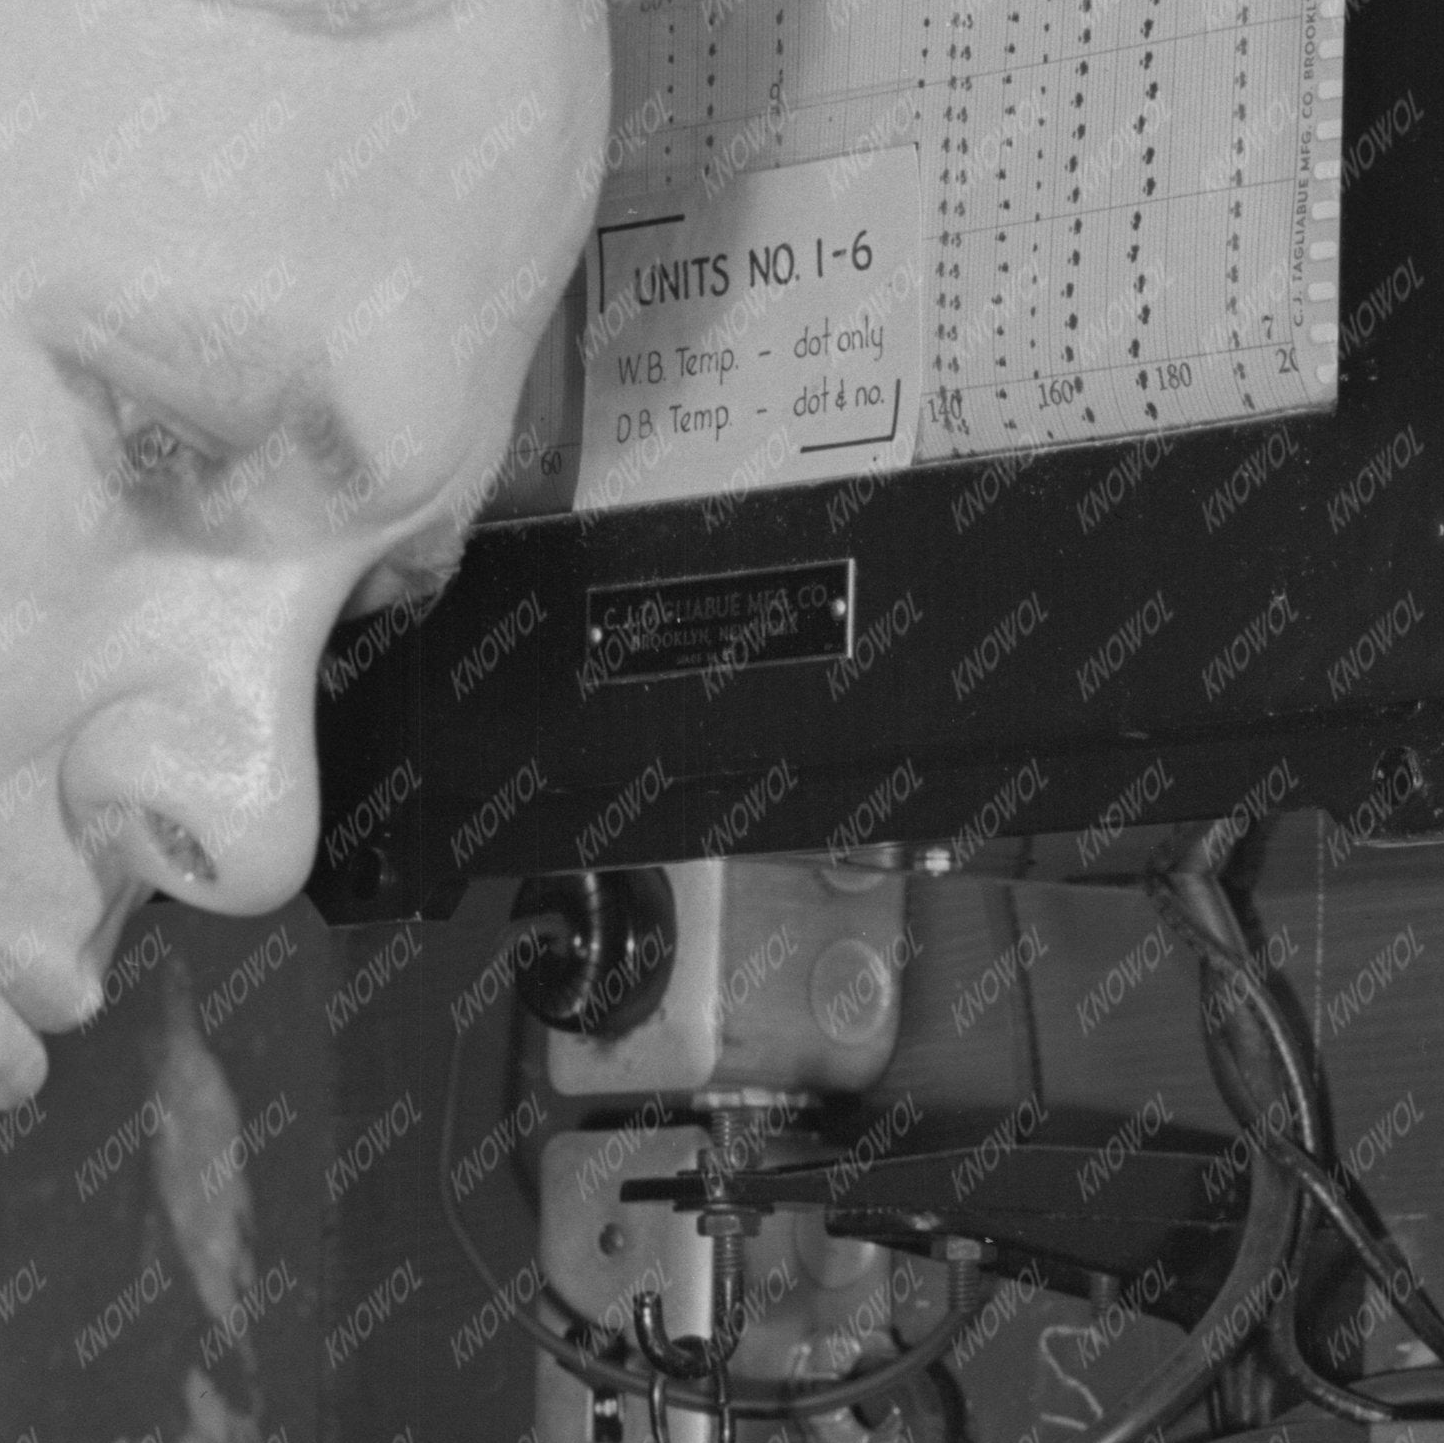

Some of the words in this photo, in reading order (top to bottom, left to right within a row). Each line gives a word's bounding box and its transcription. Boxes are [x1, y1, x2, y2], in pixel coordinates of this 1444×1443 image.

[1302, 86, 1314, 119] CO.
[1300, 125, 1313, 172] MFG.
[1293, 178, 1310, 281] TAGLIABUE
[634, 254, 730, 306] UNITS
[749, 242, 800, 287] NO.
[816, 229, 873, 278] 1-6
[617, 351, 667, 385] W.B.
[677, 347, 739, 386] Temp.
[793, 317, 832, 358] dot
[836, 315, 884, 360] only
[1261, 315, 1274, 341] 7
[1038, 380, 1075, 411] 160
[1156, 362, 1193, 391] 180
[669, 405, 734, 441] Temp.
[793, 375, 829, 417] dot
[856, 385, 885, 407] no.
